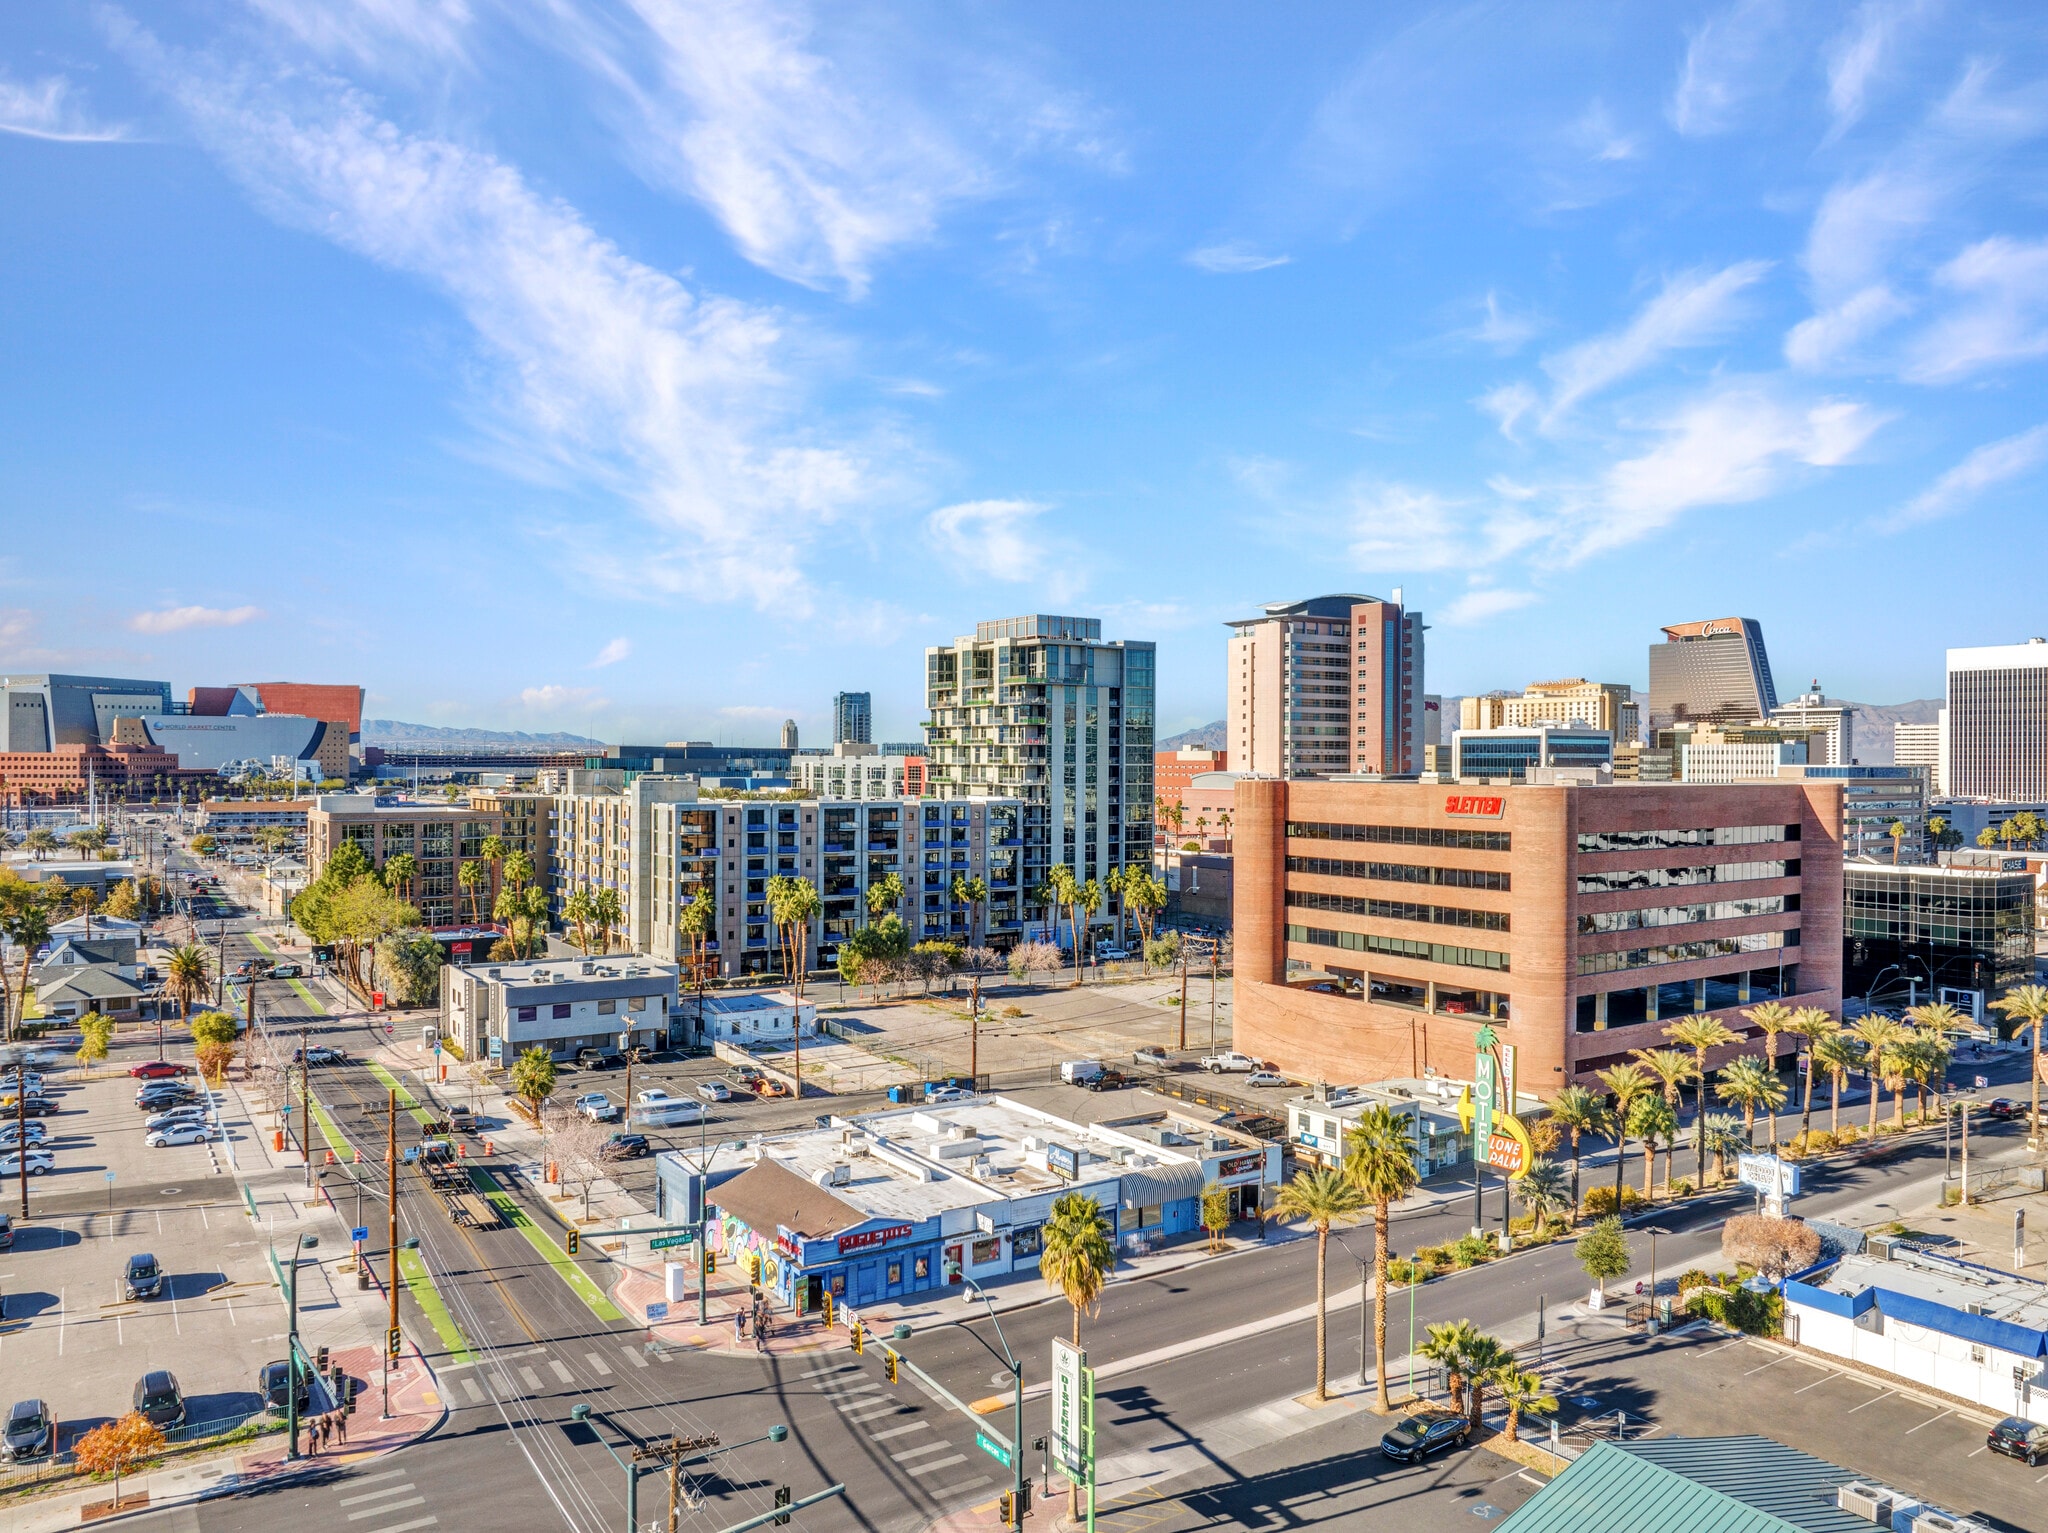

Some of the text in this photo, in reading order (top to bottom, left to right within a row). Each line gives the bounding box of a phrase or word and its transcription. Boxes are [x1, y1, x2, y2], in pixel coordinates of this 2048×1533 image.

[1701, 621, 1733, 638] Circa
[1445, 796, 1502, 815] SLETTEN
[2002, 859, 2022, 871] CHASE
[1475, 1057, 1492, 1163] MOTEL
[1489, 1137, 1521, 1156] LONE
[1489, 1153, 1522, 1172] PALM
[1743, 1162, 1789, 1181] WEDDIG
[654, 1239, 666, 1247] Las
[667, 1236, 686, 1245] Vegas
[838, 1229, 884, 1254] ROGUE
[880, 1223, 912, 1246] TOYS
[1060, 1374, 1070, 1460] DISPENSARY
